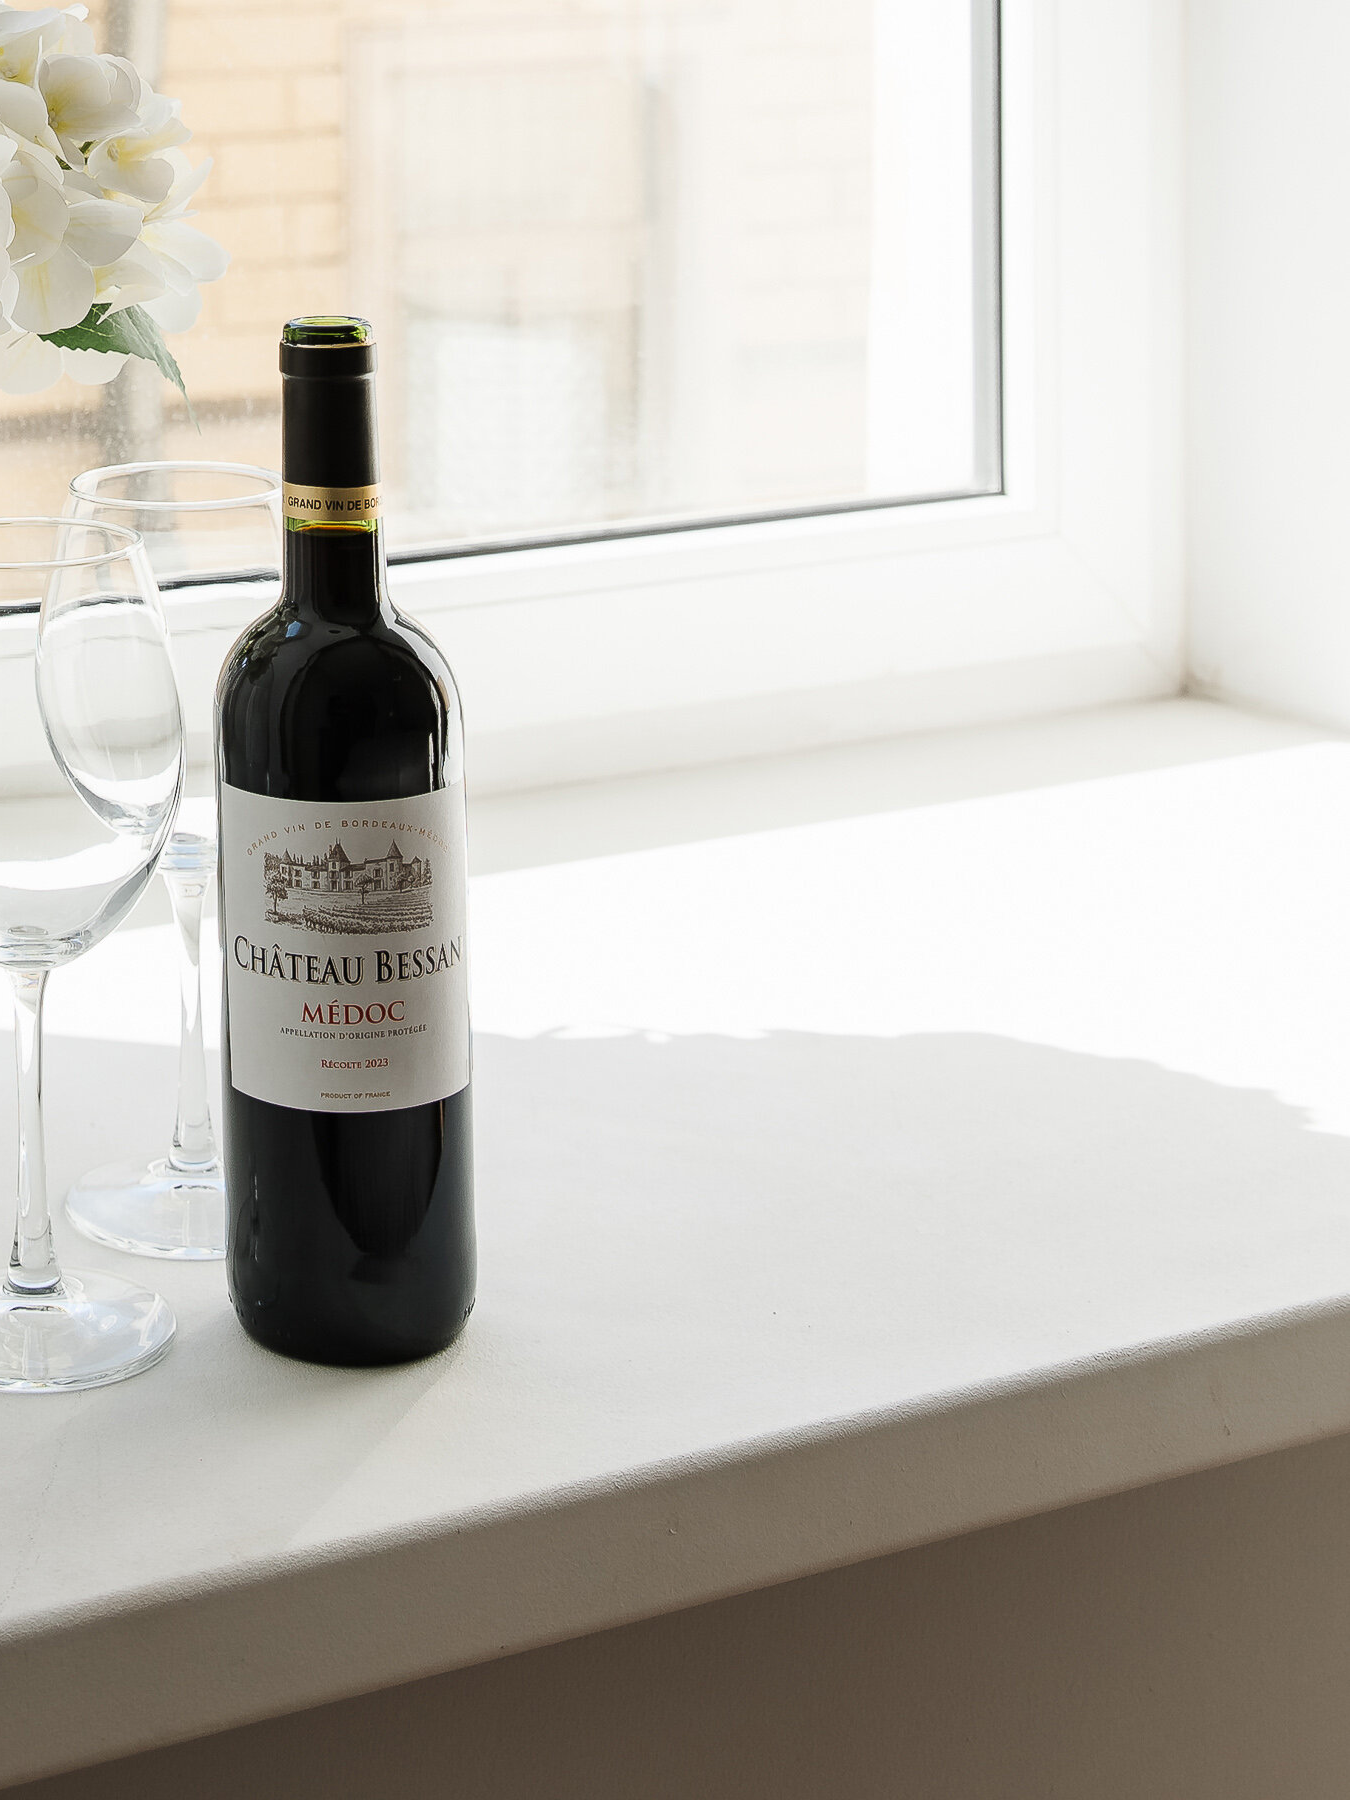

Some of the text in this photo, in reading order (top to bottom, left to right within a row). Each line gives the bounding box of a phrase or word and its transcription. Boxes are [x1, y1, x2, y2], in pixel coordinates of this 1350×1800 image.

[288, 496, 321, 510] GRAND
[325, 500, 343, 511] VIN
[347, 500, 361, 511] DE
[246, 831, 277, 855] GRAND
[284, 824, 305, 834] VIN
[315, 821, 331, 829] DE
[234, 935, 463, 986] CHÂTEAU BESSAN
[301, 999, 405, 1025] MÉDOC
[280, 1024, 427, 1040] APPELLATION D'ORIGINE PROTÉGÉE
[321, 1058, 389, 1069] RÉCOLTE 2023
[365, 1091, 391, 1099] FRANCE
